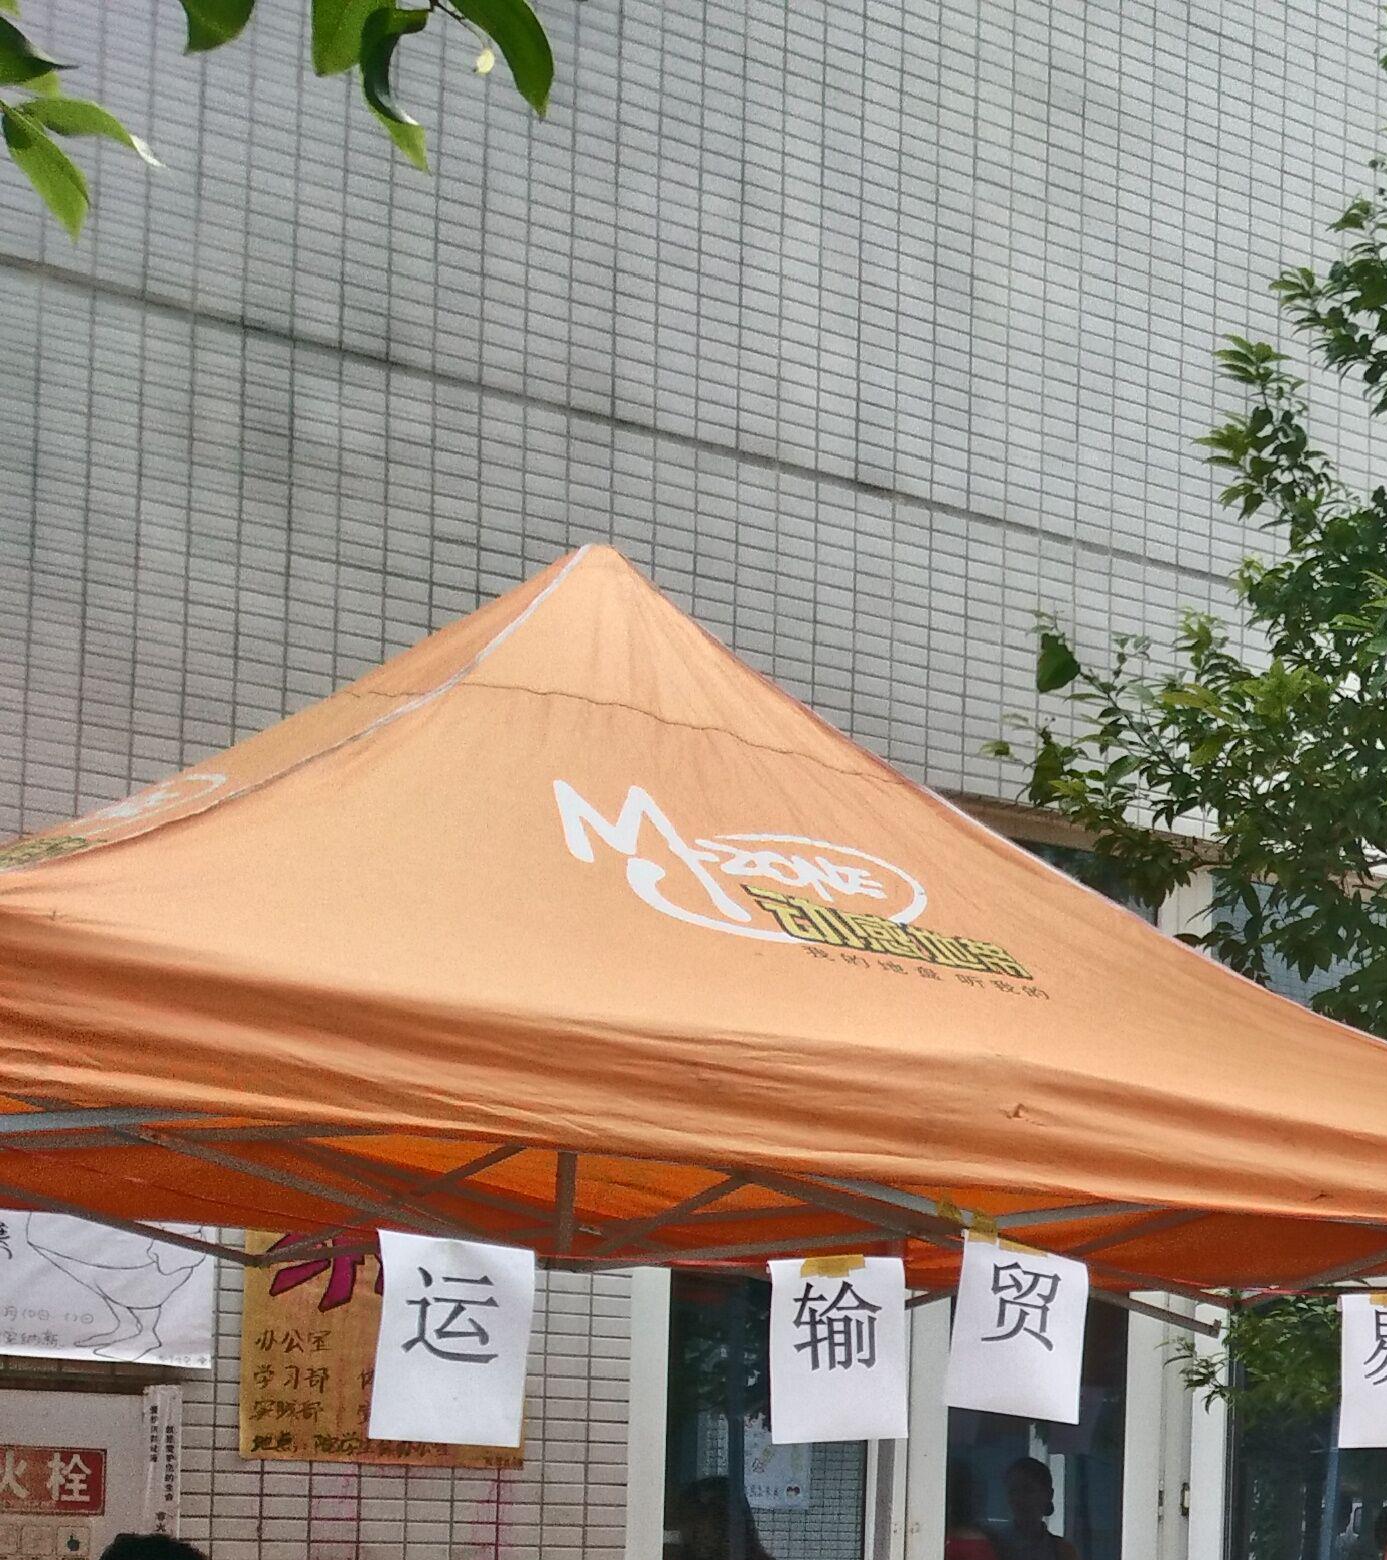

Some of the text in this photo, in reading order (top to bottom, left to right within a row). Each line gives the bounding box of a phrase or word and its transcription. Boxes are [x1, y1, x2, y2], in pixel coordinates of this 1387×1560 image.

[255, 1330, 331, 1354] 办公室
[401, 1266, 499, 1364] 运
[792, 1281, 882, 1371] 输
[981, 1262, 1061, 1352] 贸
[253, 1363, 329, 1394] 学习部
